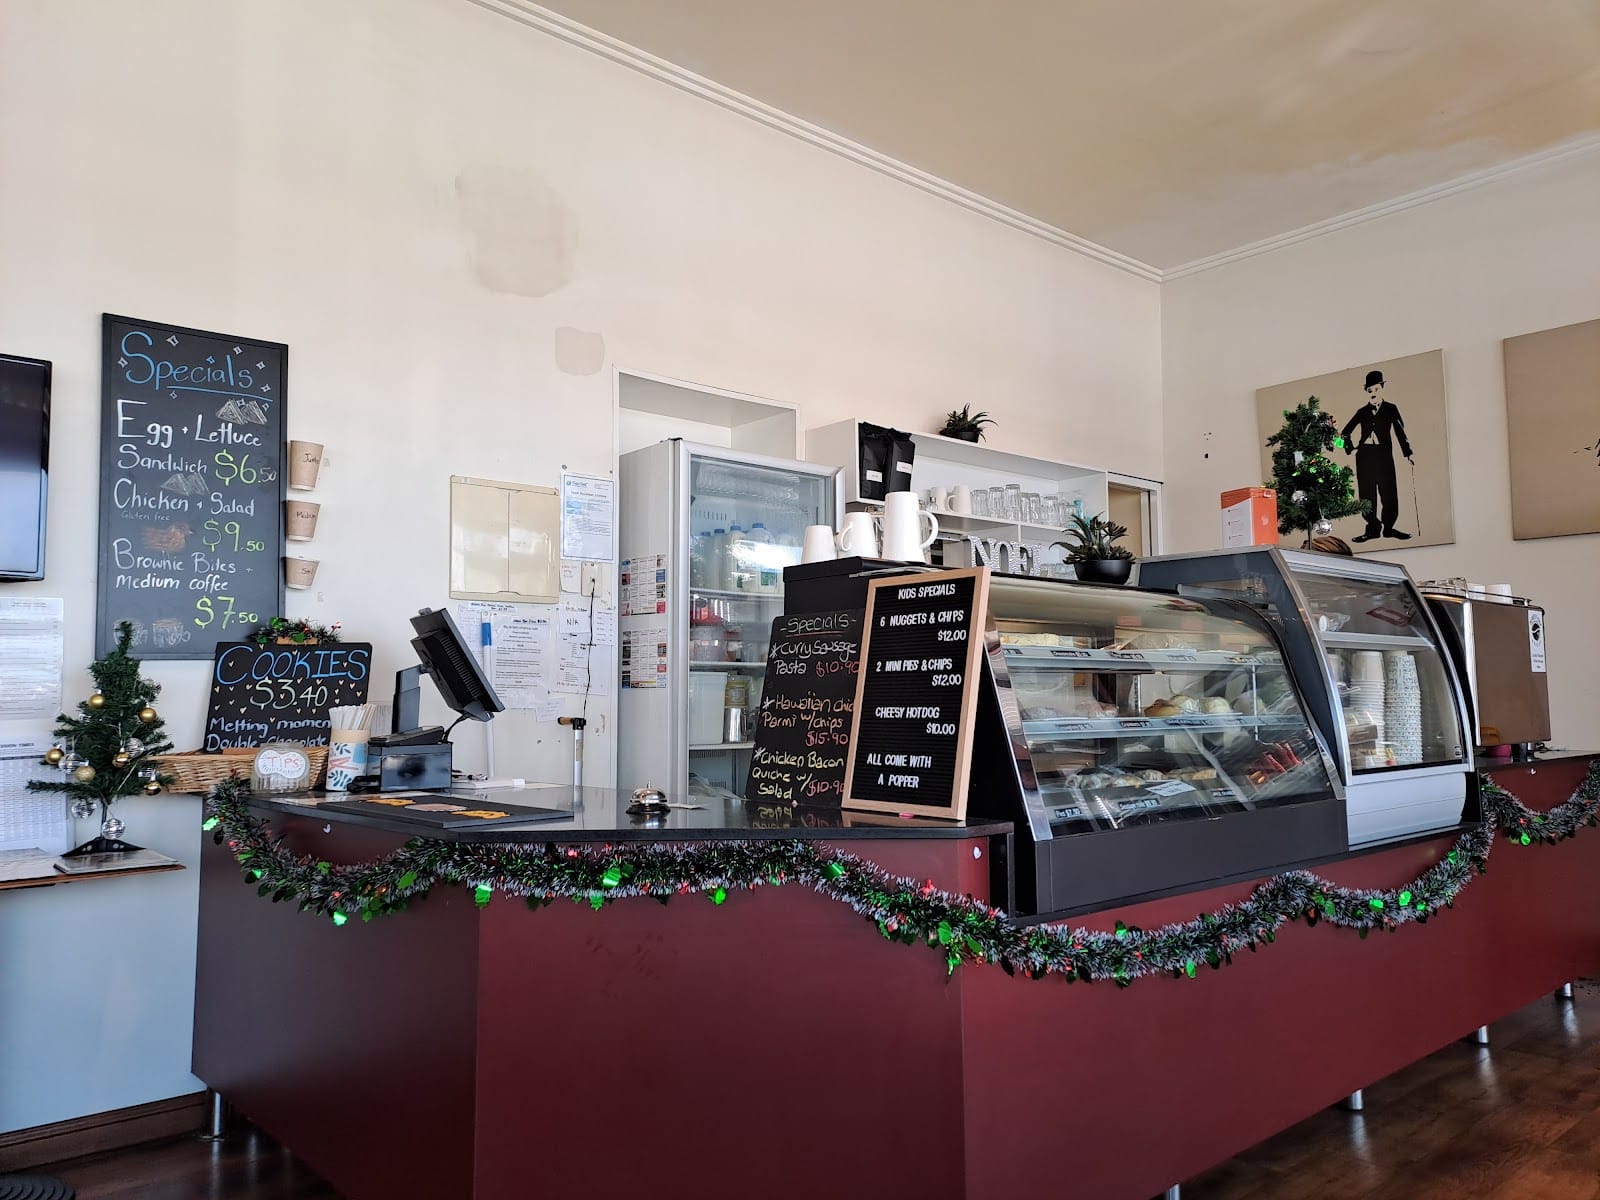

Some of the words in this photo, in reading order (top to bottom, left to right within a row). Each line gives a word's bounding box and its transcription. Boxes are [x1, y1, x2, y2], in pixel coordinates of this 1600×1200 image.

[121, 331, 253, 390] Specials
[117, 399, 173, 448] Egg
[194, 414, 262, 446] Lettuce
[117, 443, 207, 473] Sandwich
[214, 449, 277, 486] $6.50
[113, 477, 189, 511] Chicken
[210, 492, 255, 517] Salad
[202, 518, 265, 552] $9.50
[113, 538, 185, 571] Brownie
[192, 551, 236, 574] Bites
[189, 573, 229, 594] coffee
[898, 588, 916, 600] KIDS
[918, 584, 956, 597] SPECIALS
[194, 595, 259, 630] $7.50
[880, 616, 886, 627] 6
[889, 613, 927, 627] NUGGETS
[929, 611, 936, 624] &
[937, 610, 964, 623] CHIPS
[937, 630, 967, 642] $12.00
[216, 645, 369, 685] COOKIES
[774, 659, 807, 676] Pasta
[876, 661, 882, 672] 2
[885, 660, 902, 673] MINI
[902, 660, 918, 672] PIES
[931, 674, 962, 687] $12.00
[250, 676, 328, 710] $3.40
[762, 712, 798, 729] Parmi
[875, 707, 904, 720] CHEESY
[926, 723, 956, 736] $10.00
[805, 731, 849, 747] $15.90
[265, 756, 300, 769] TIPS
[807, 751, 844, 769] Bacon
[867, 753, 882, 766] ALL
[884, 754, 908, 767] COME
[909, 755, 931, 769] WITH
[878, 774, 884, 785] A
[888, 774, 919, 789] POPPER
[758, 783, 793, 800] Salad
